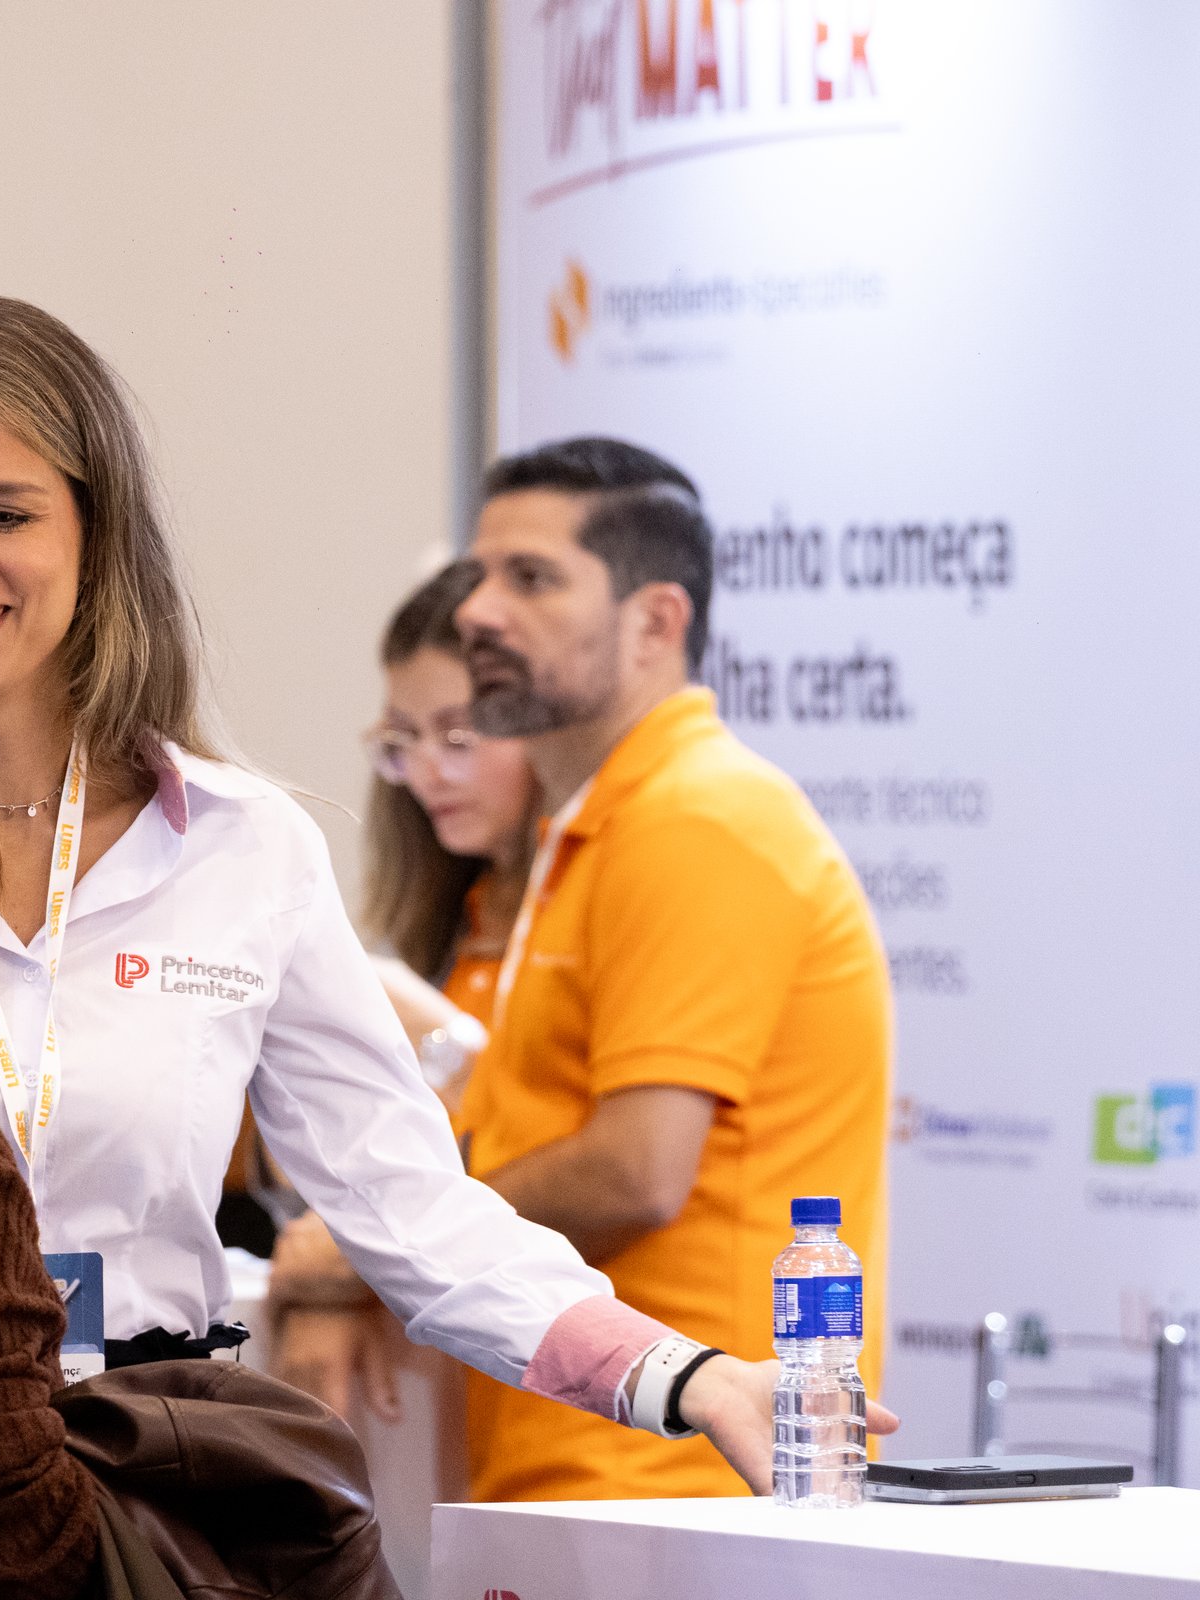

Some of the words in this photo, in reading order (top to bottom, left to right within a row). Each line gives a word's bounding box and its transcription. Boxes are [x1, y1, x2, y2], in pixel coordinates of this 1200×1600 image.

[714, 503, 826, 590] enho
[841, 516, 1012, 612] começa
[706, 634, 773, 722] lha
[788, 642, 910, 724] certa.
[59, 823, 75, 871] LUBES
[49, 891, 65, 937] LUBES
[160, 974, 249, 1003] Lemitar
[161, 954, 264, 991] Princeton
[37, 1073, 53, 1128] LUBES
